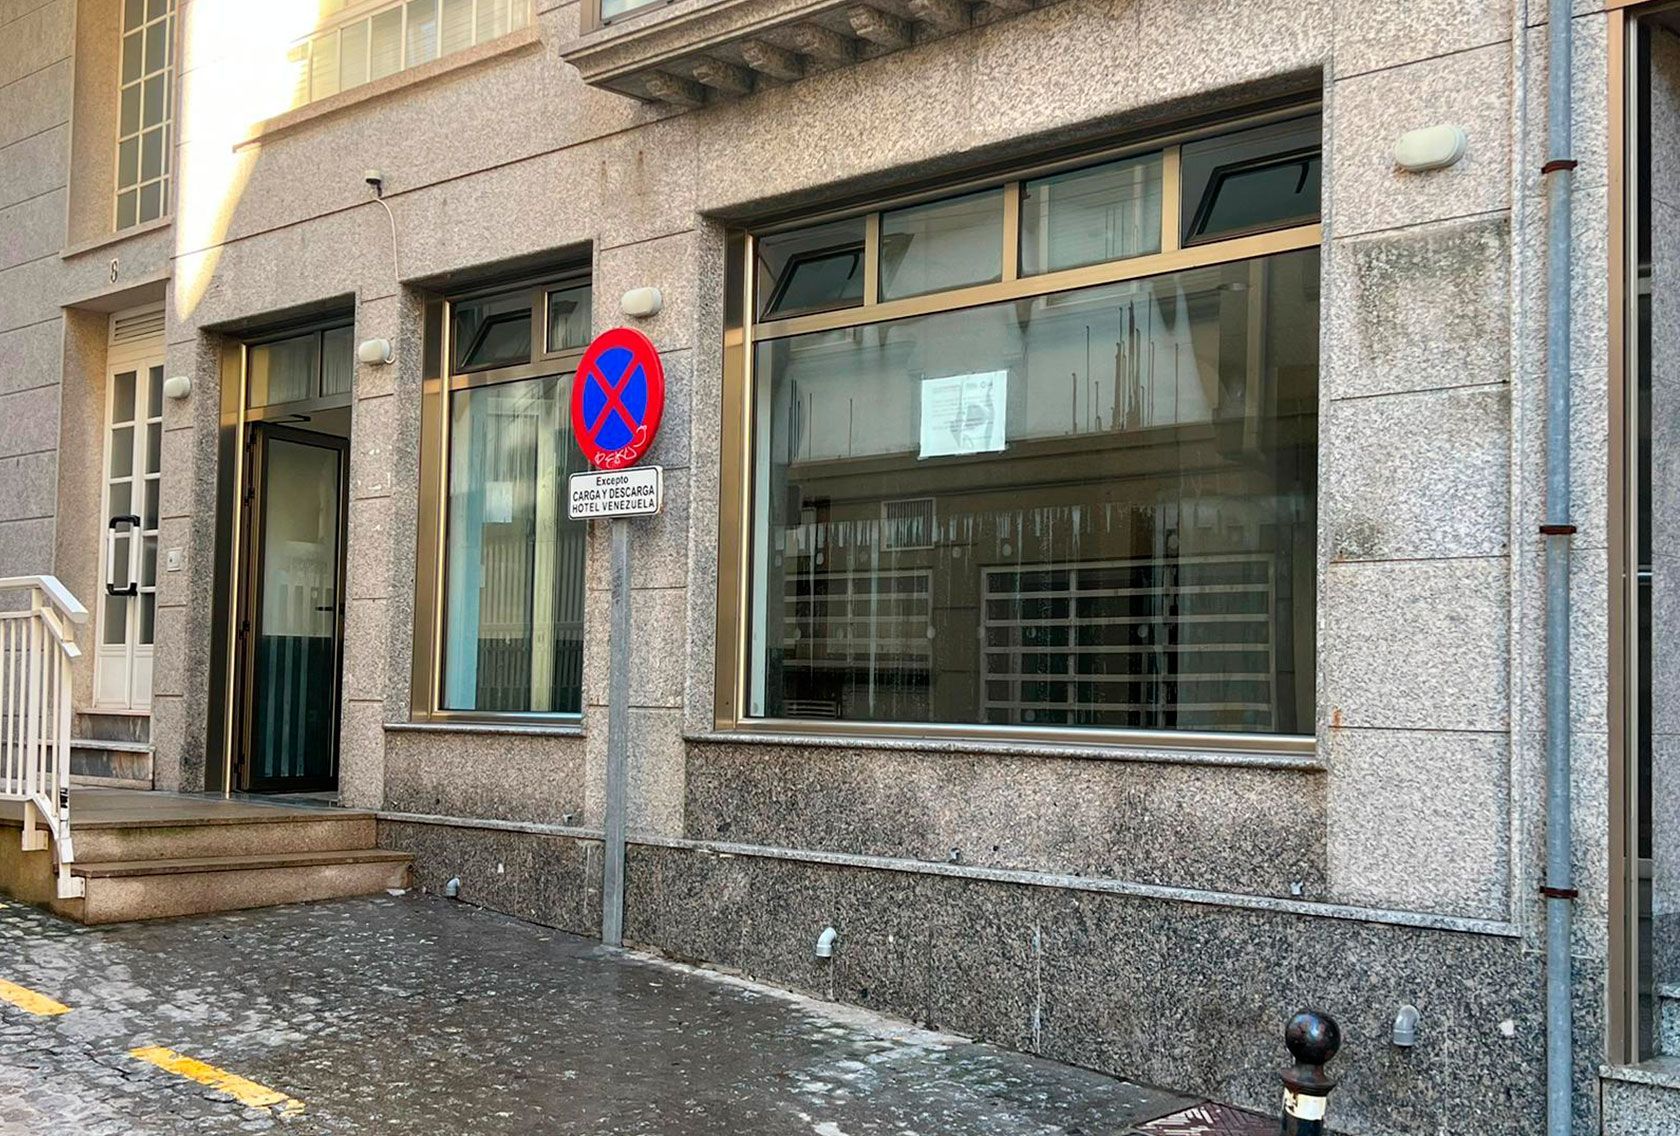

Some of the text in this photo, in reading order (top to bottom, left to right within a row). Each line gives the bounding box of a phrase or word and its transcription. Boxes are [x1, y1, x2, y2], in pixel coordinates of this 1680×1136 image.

[596, 476, 629, 487] Excepto
[573, 485, 655, 502] CARGA Y DESCARGA
[572, 498, 655, 513] HOTEL VENEZUELA
